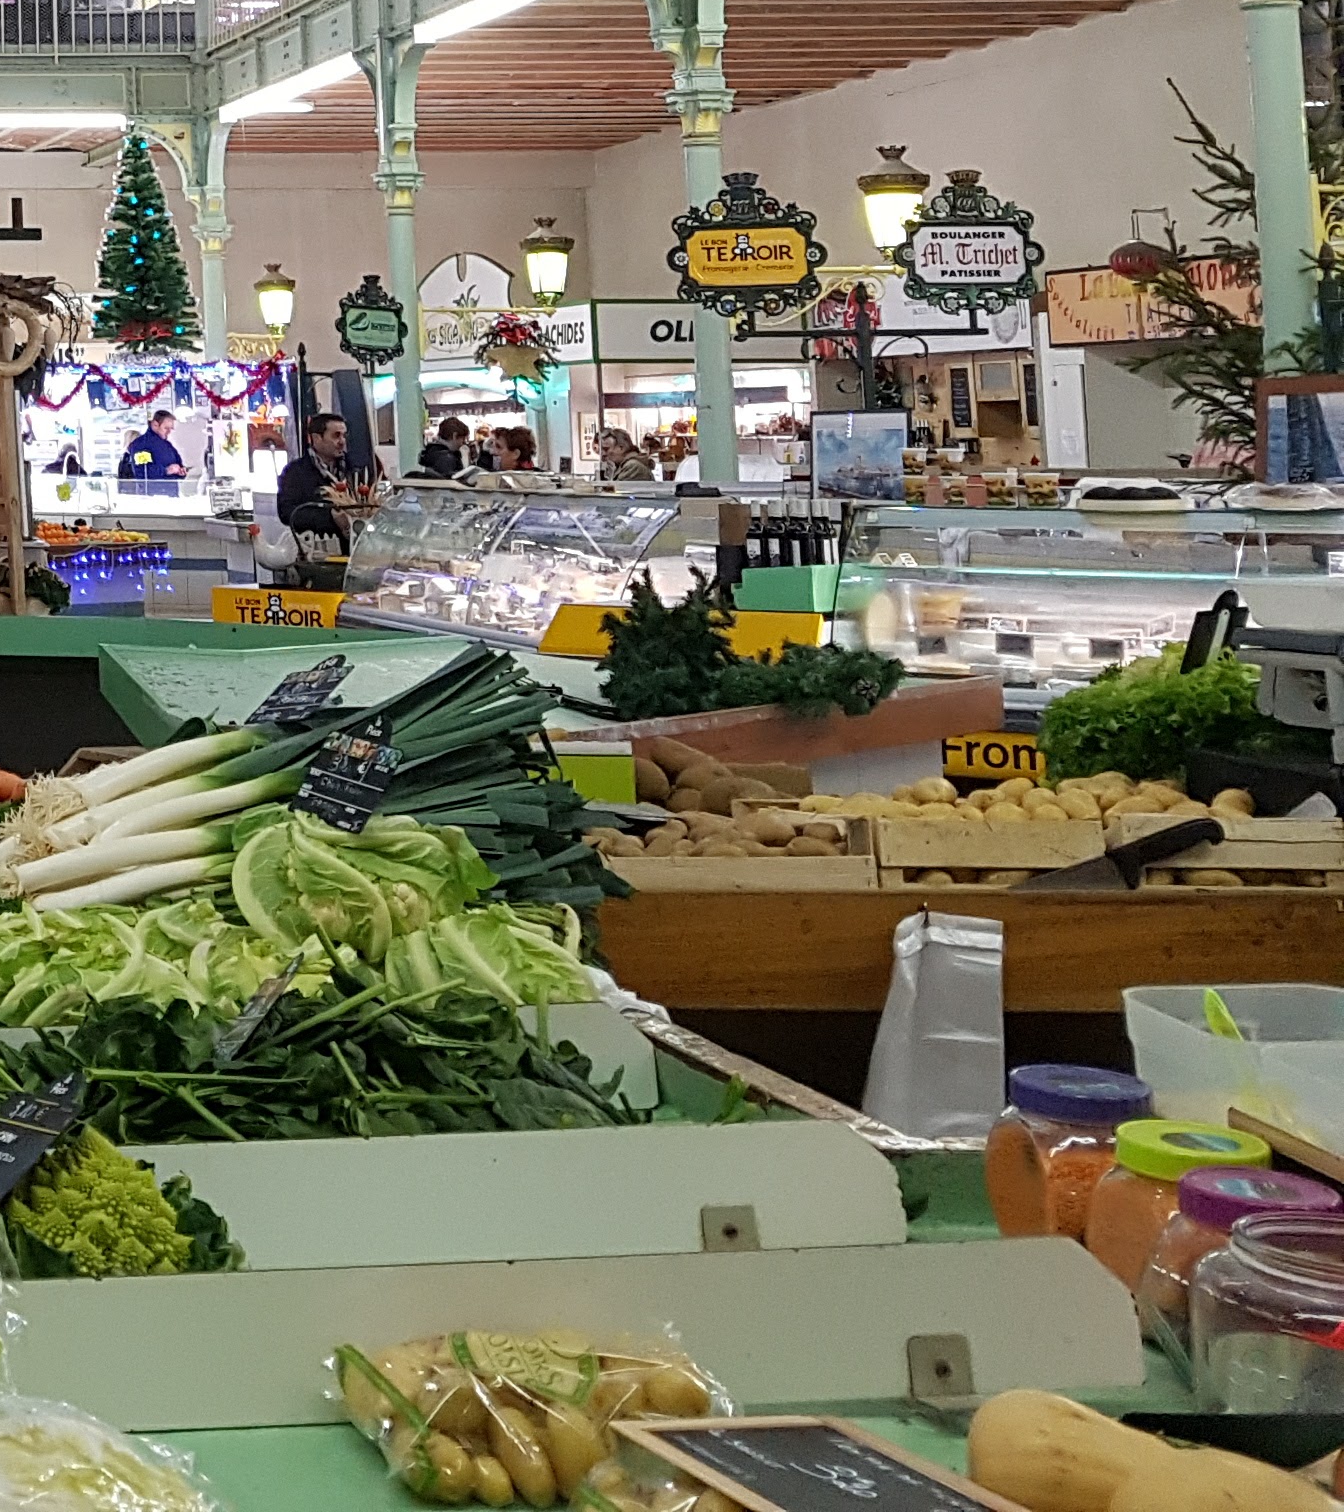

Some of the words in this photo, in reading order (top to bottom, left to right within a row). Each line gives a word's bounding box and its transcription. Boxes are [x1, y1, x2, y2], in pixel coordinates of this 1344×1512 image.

[931, 231, 1006, 240] BOULANGER
[701, 245, 794, 262] TERROIR
[920, 242, 950, 268] M.
[955, 242, 1019, 269] Trichet
[940, 269, 1002, 278] PATISSIER
[235, 597, 243, 605] LE
[245, 598, 261, 606] BON
[236, 605, 324, 628] TERROIR
